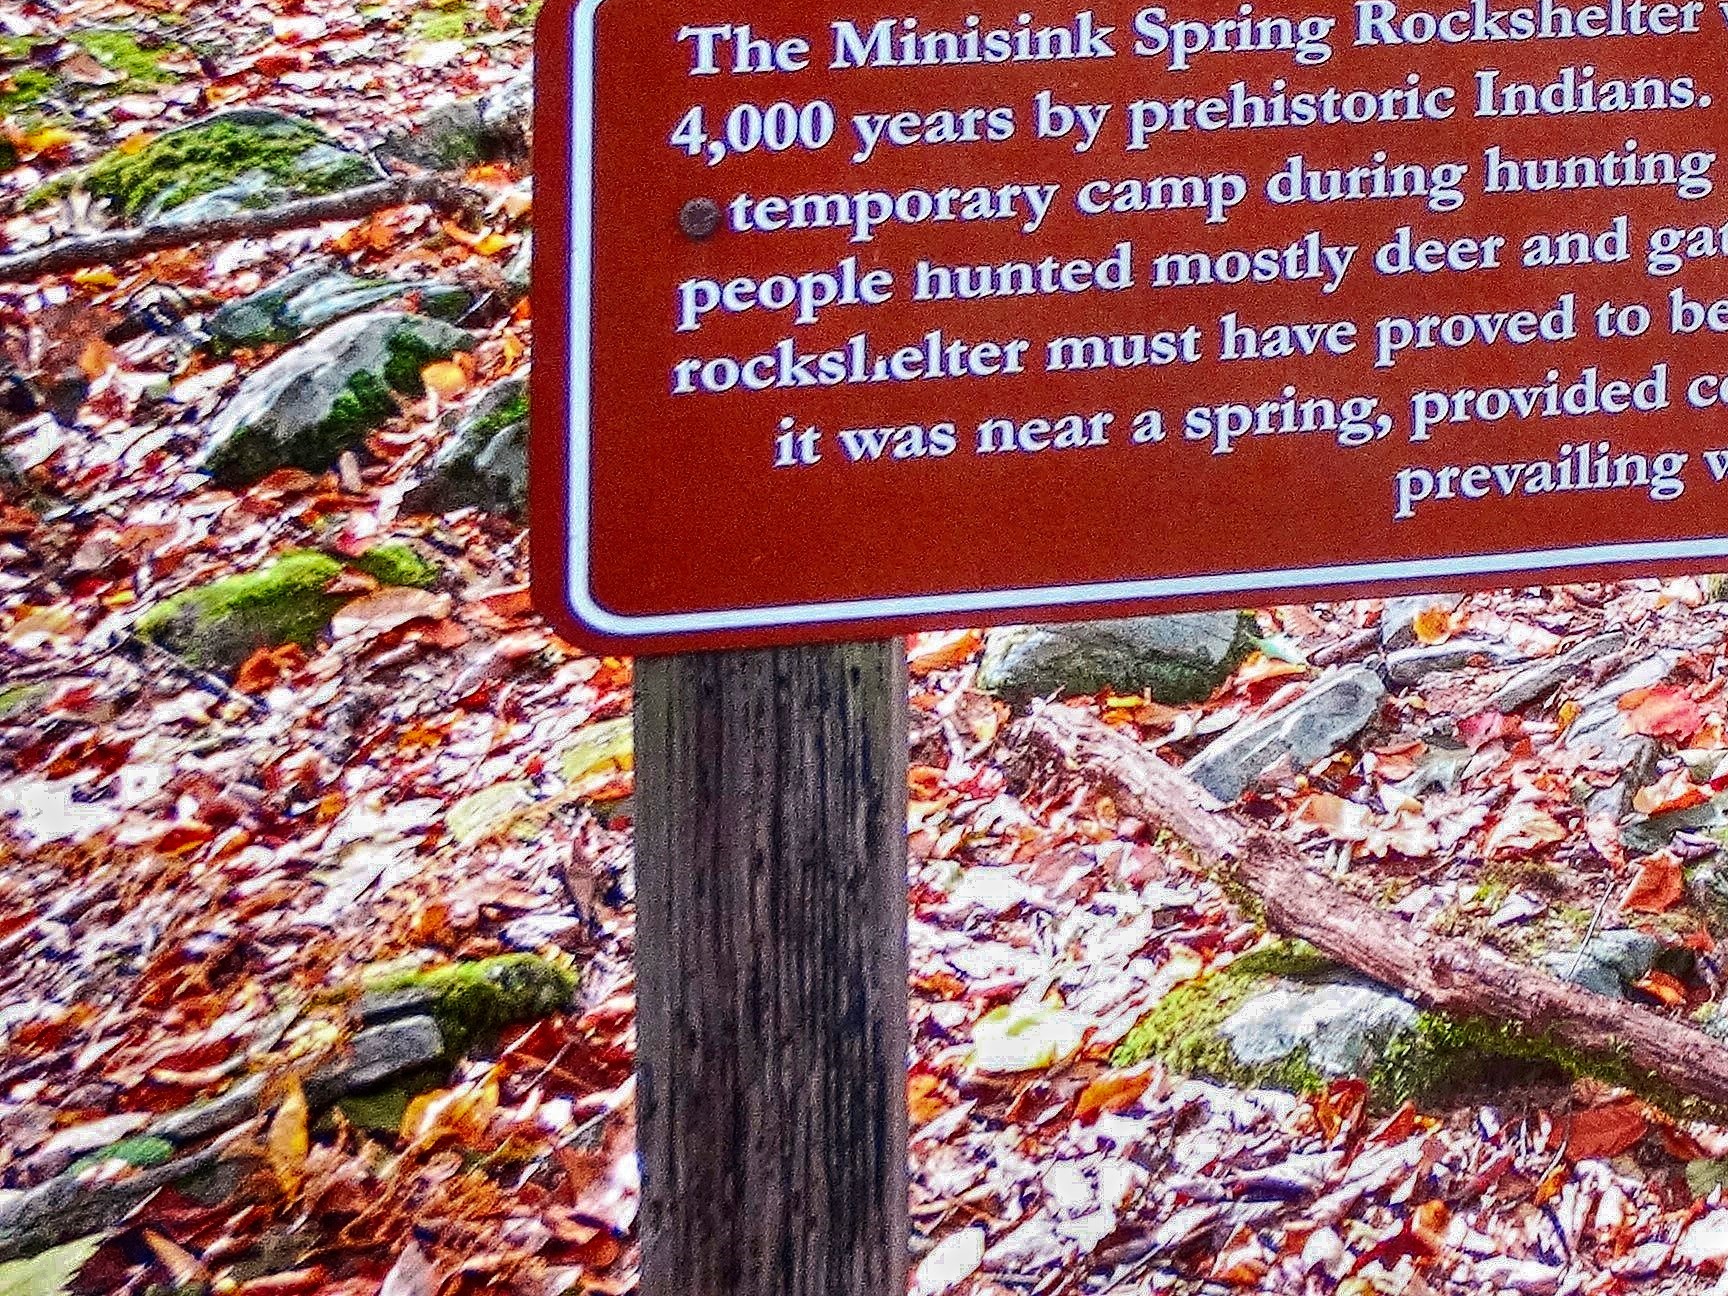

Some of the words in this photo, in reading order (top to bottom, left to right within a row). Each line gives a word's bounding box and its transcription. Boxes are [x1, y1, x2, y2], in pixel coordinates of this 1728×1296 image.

[677, 23, 810, 76] The
[828, 10, 1117, 70] Minisink
[1132, 3, 1337, 72] Spring
[669, 100, 835, 166] 4,000
[850, 107, 1015, 164] years
[1034, 89, 1113, 153] by
[1125, 72, 1456, 151] prehistoric
[1472, 65, 1712, 120] Indians.
[729, 183, 1061, 243] temporary
[1077, 172, 1247, 225] camp
[1266, 150, 1469, 212] during
[1482, 138, 1717, 200] hunting
[675, 255, 894, 333] people
[913, 241, 1135, 301] hunted
[1151, 231, 1359, 294] mostly
[1375, 225, 1506, 275] deer
[1522, 214, 1632, 267] and
[1045, 325, 1203, 372] must
[1219, 311, 1358, 362] have
[1373, 292, 1577, 369] proved
[1594, 301, 1651, 338] to
[772, 416, 823, 468] it
[836, 422, 957, 461] was
[975, 411, 1115, 454] near
[1132, 410, 1167, 443] a
[1184, 385, 1393, 455] spring,
[1408, 363, 1671, 442] provided
[1393, 441, 1689, 519] prevailing
